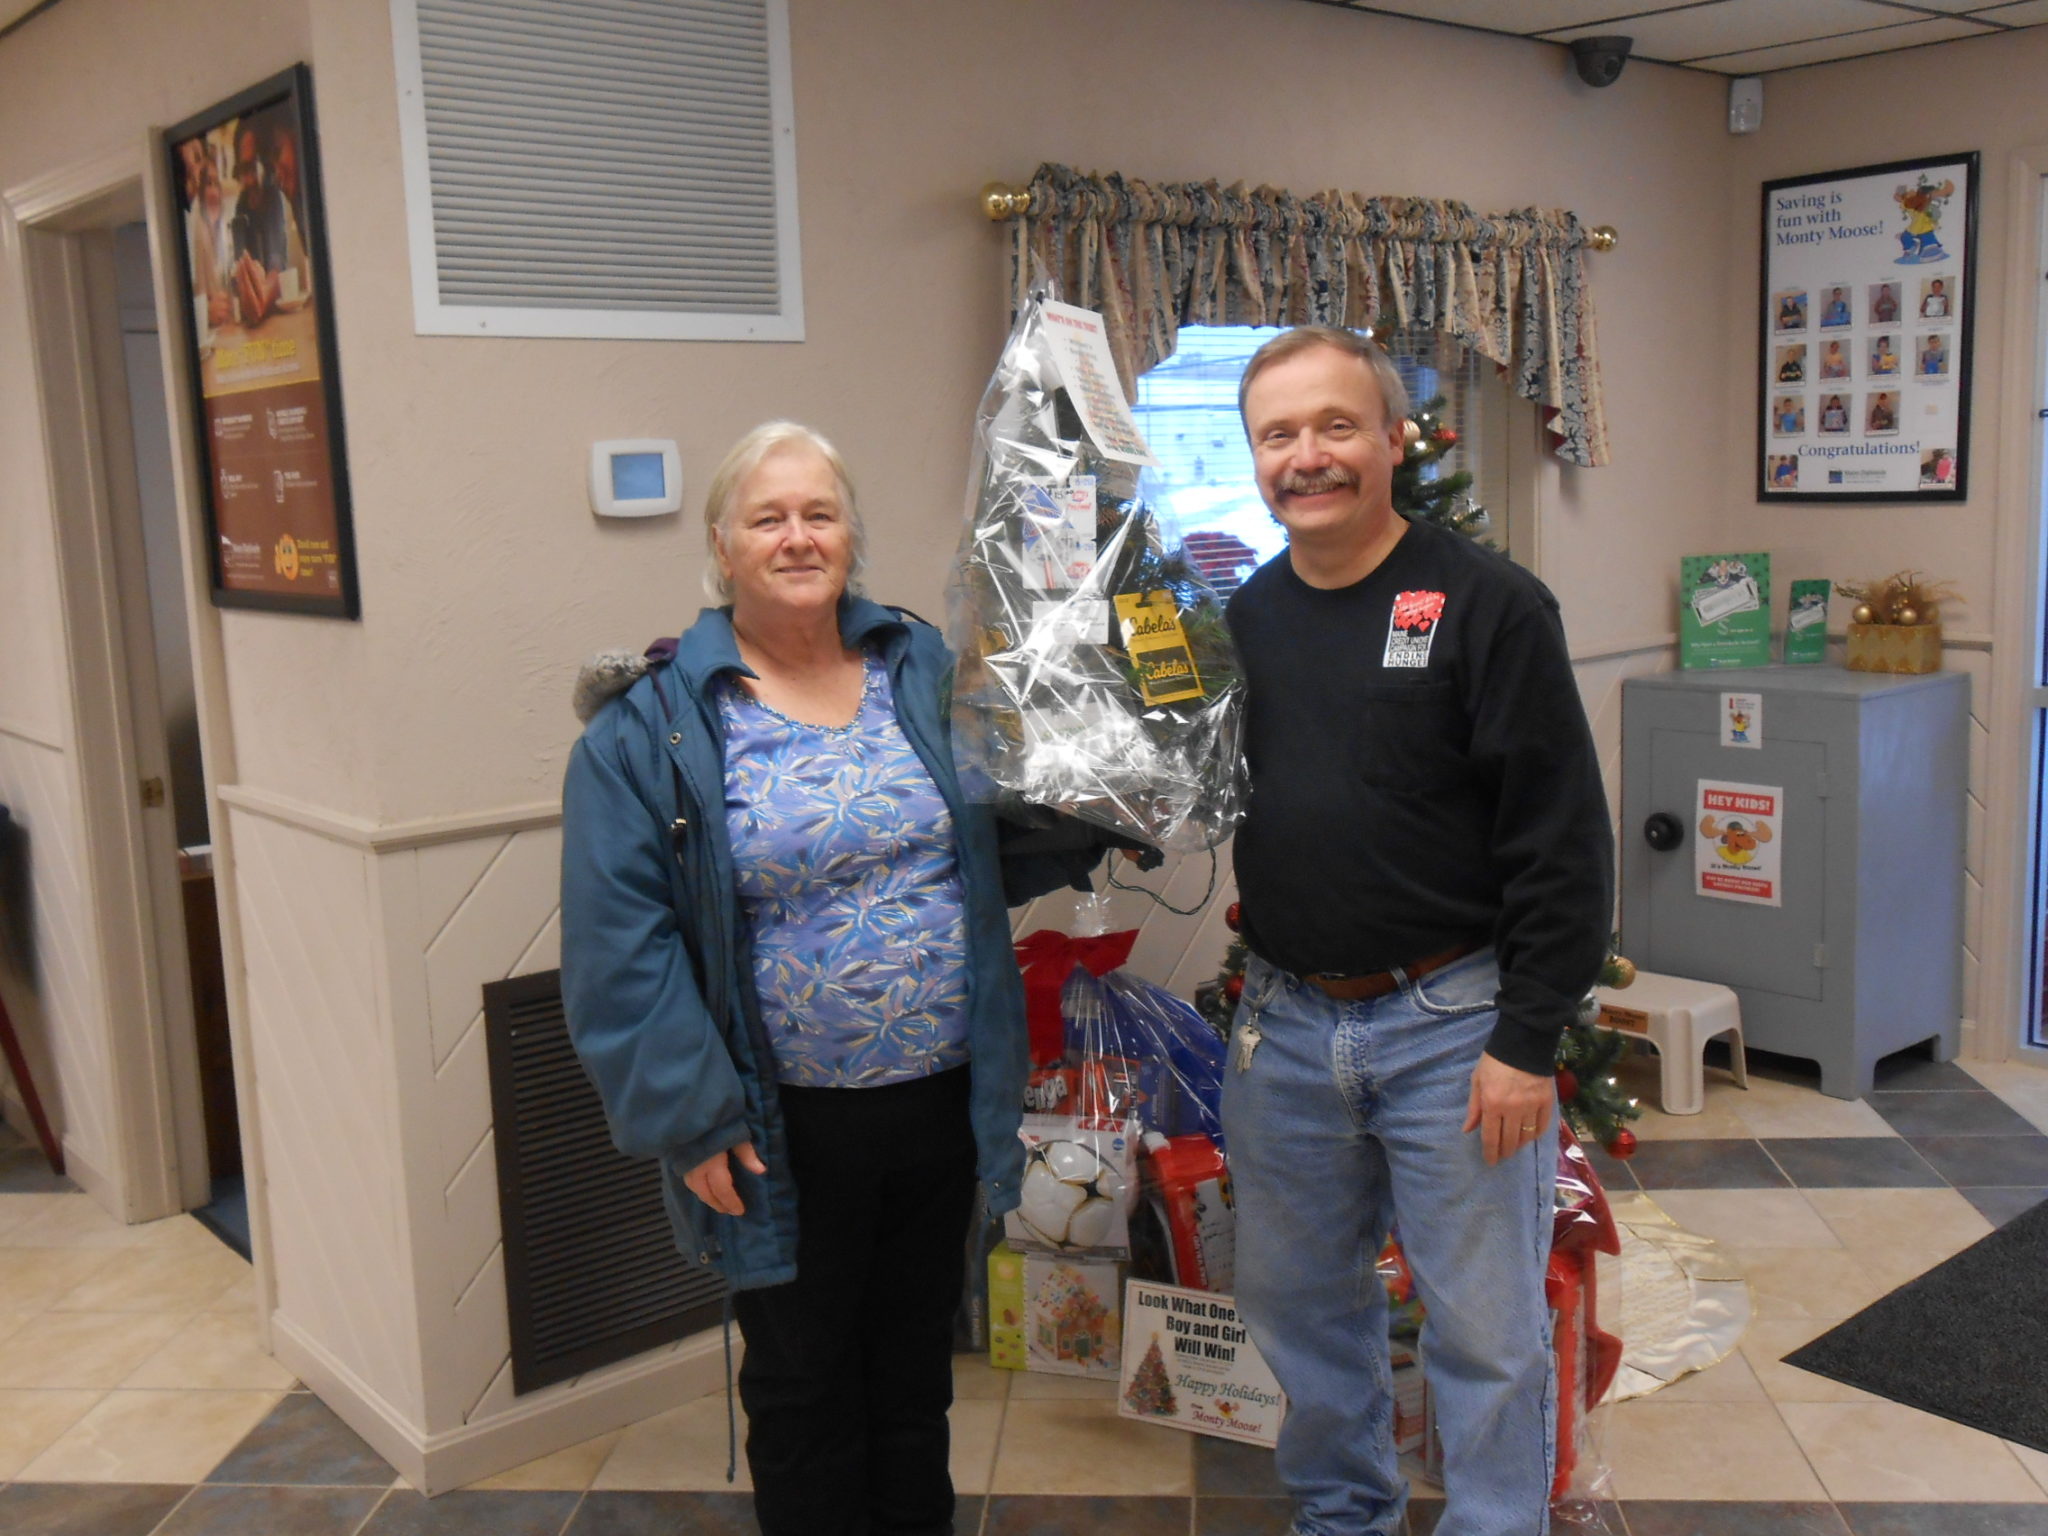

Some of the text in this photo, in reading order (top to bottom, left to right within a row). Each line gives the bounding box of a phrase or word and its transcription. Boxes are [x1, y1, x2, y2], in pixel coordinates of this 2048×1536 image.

[1776, 190, 1843, 211] Saving is
[1777, 208, 1841, 228] fun with
[1776, 220, 1884, 246] Monty Moose!
[1798, 440, 1920, 459] Congratulations!
[1707, 793, 1771, 811] HEY KIDS!
[1023, 1074, 1068, 1111] enga
[1138, 1290, 1235, 1322] Look What One
[1166, 1315, 1246, 1344] Boy and Girl
[1174, 1336, 1236, 1362] Will Win!
[1175, 1374, 1281, 1408] Happy Holidays!
[1192, 1411, 1263, 1433] Monty Moose!
